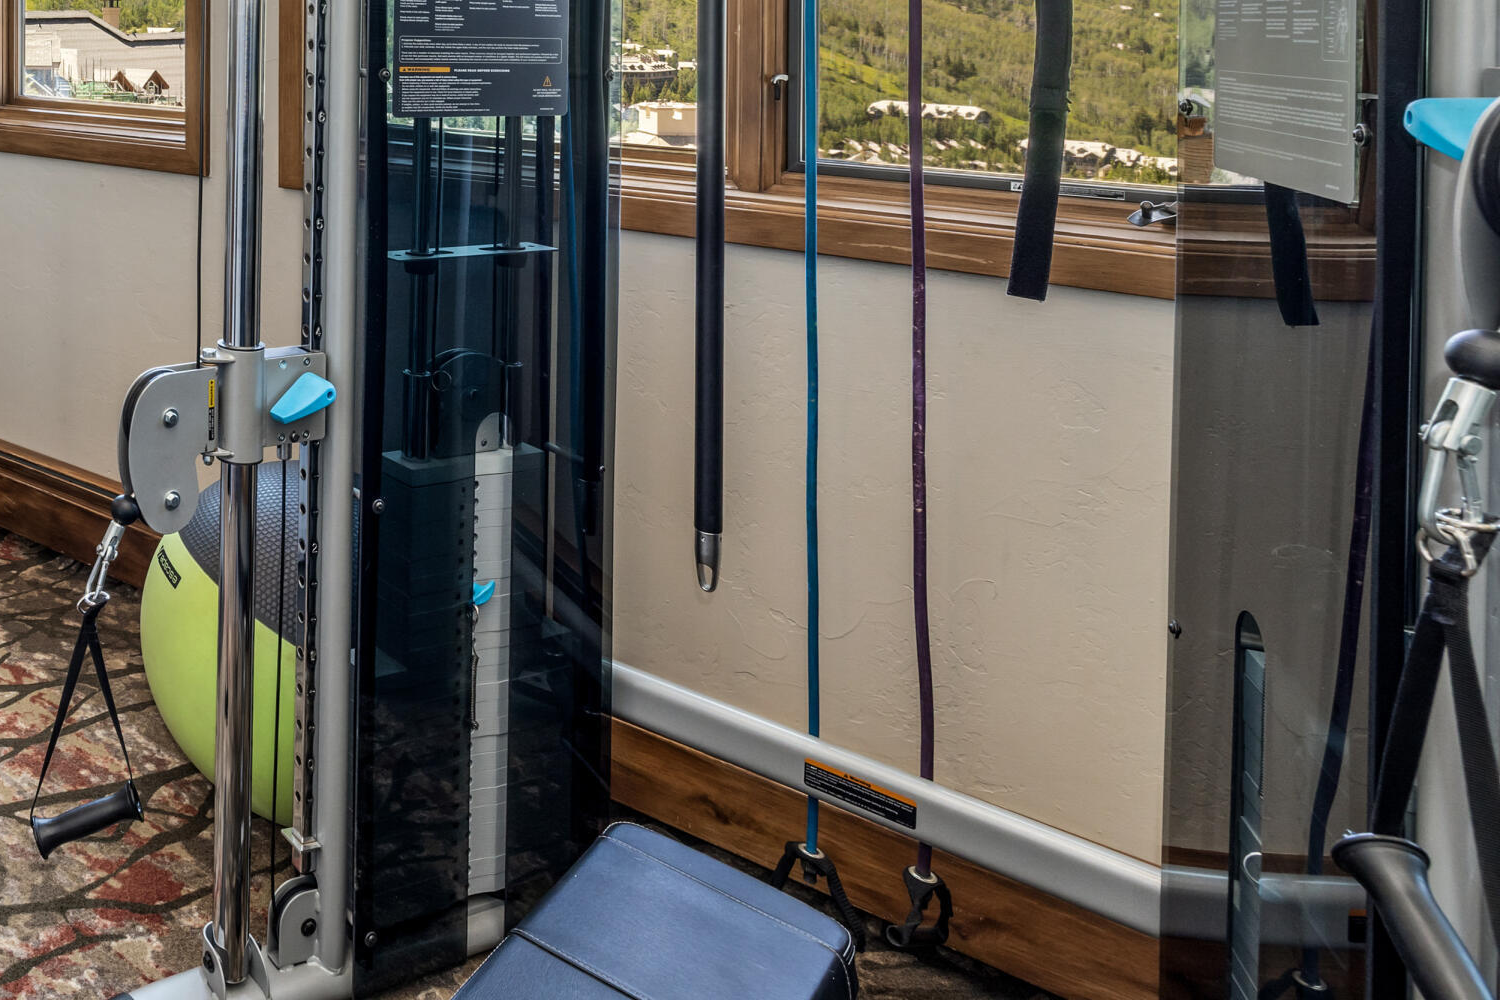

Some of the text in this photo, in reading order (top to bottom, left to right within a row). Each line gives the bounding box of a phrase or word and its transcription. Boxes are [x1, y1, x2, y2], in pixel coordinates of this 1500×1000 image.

[318, 110, 326, 123] 6
[316, 217, 324, 231] 5
[311, 543, 319, 554] 2
